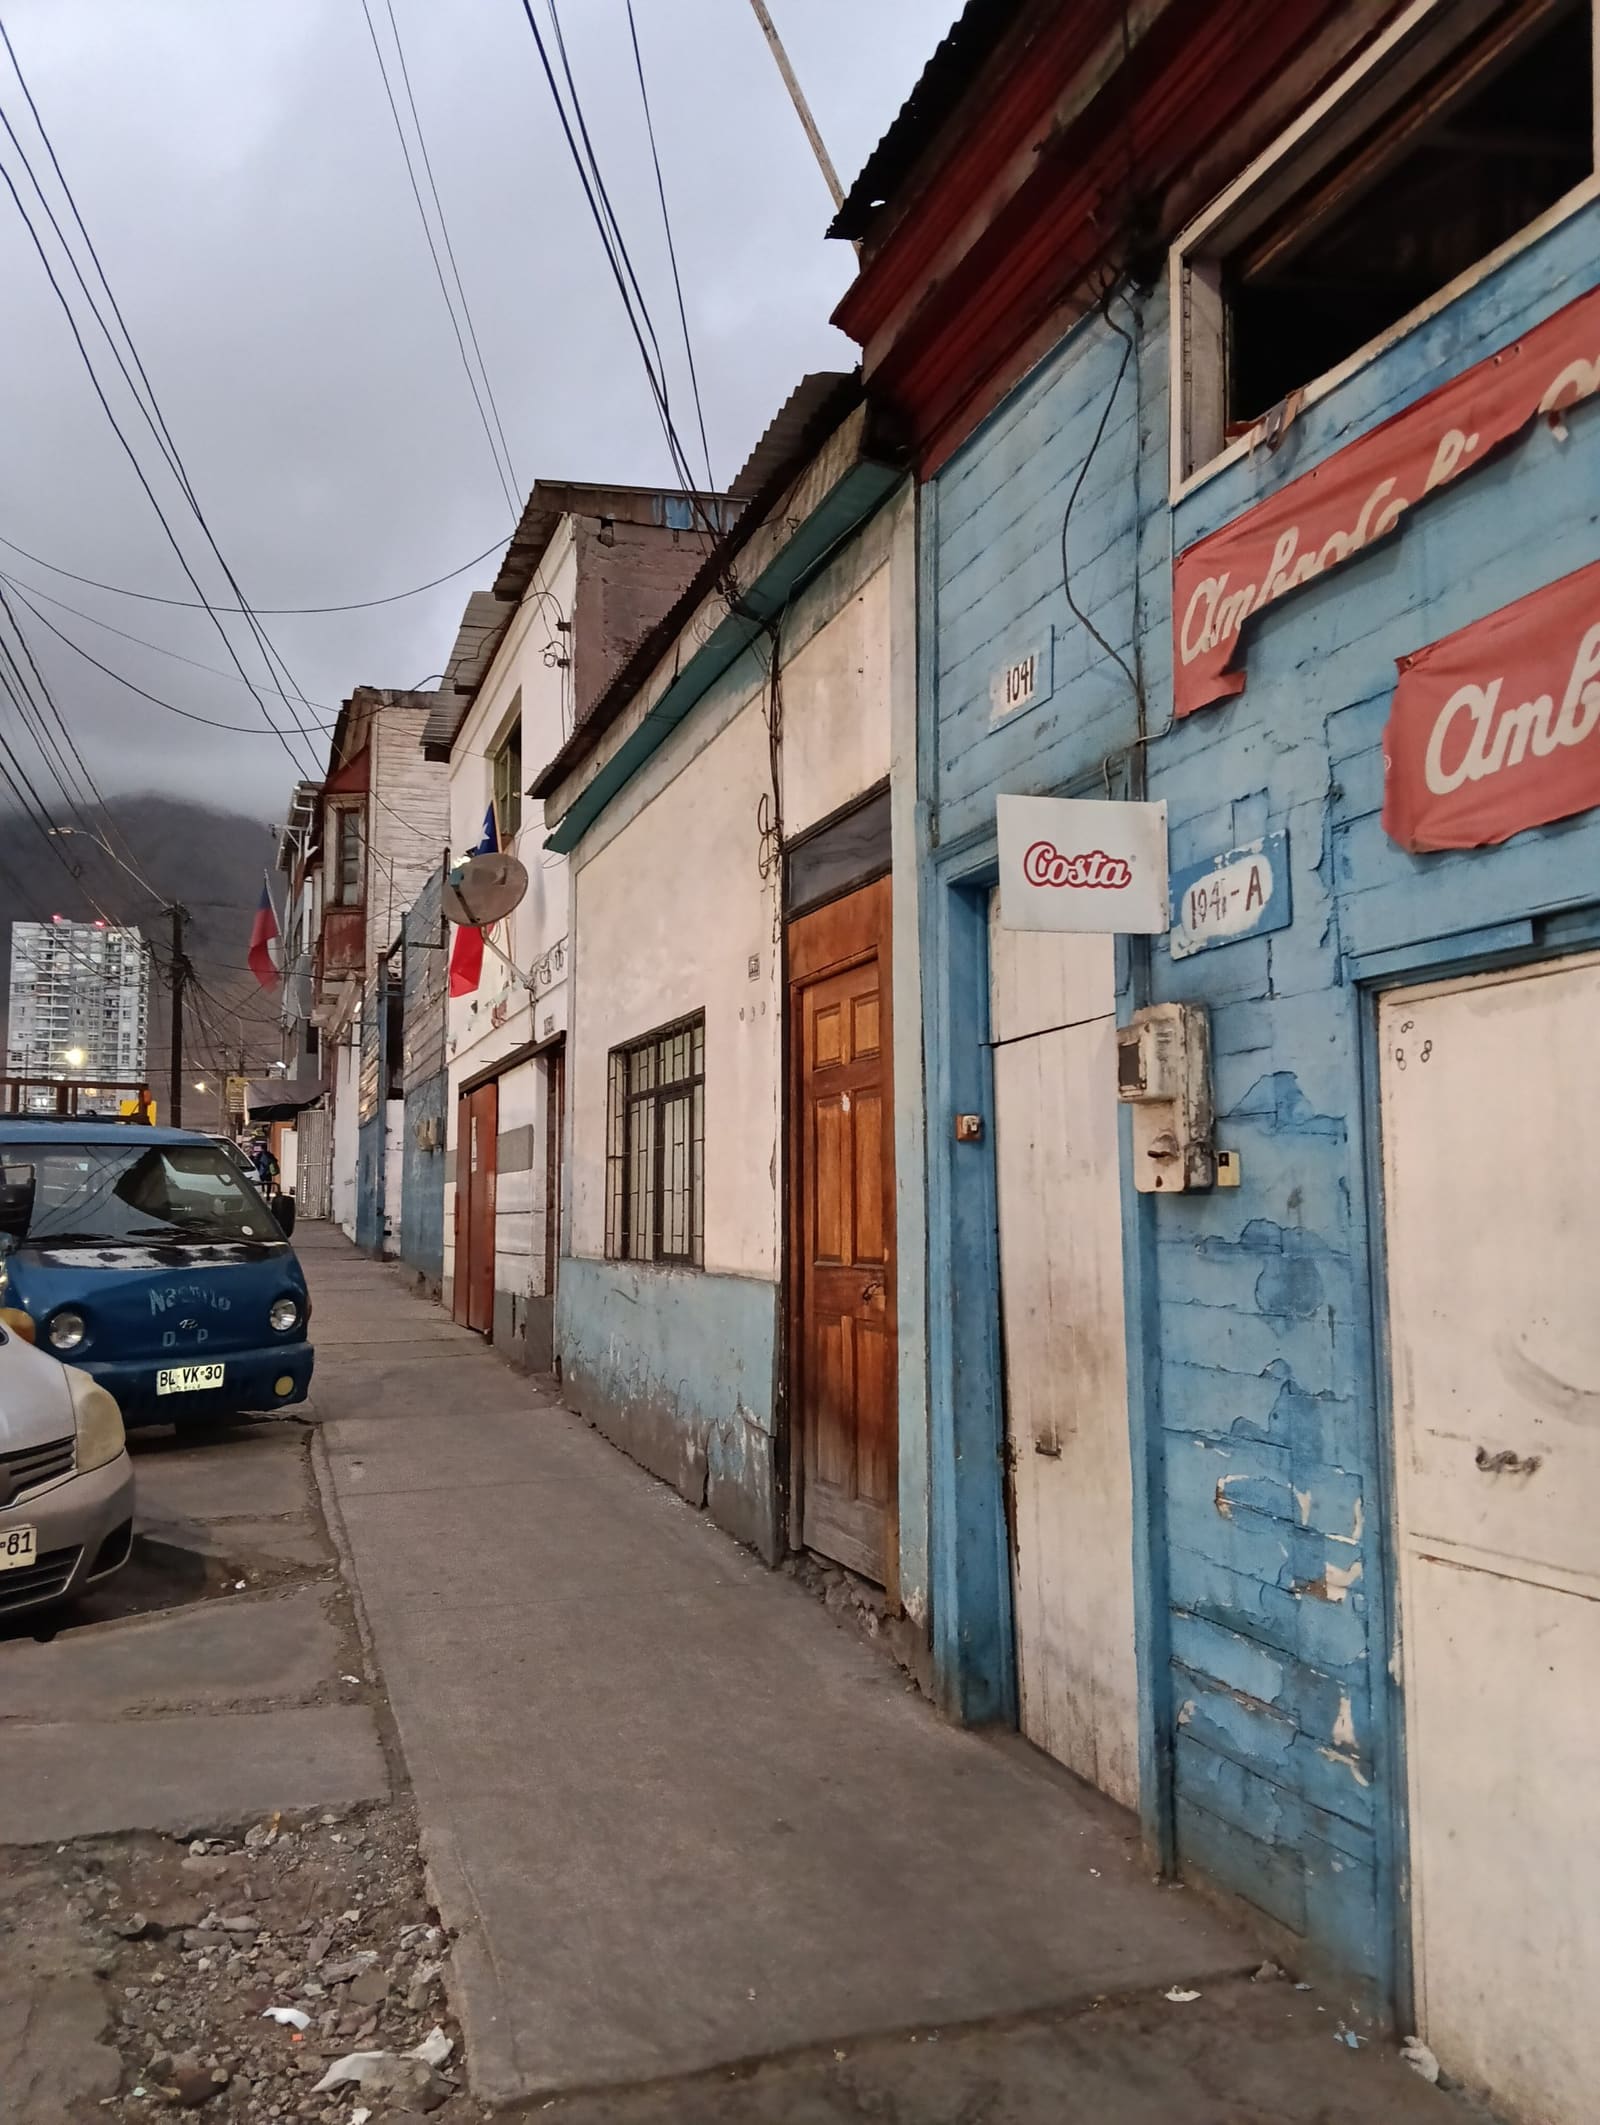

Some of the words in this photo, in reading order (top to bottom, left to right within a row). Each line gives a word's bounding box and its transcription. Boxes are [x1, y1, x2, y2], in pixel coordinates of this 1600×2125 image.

[1181, 429, 1480, 666] Ambrosl
[1006, 655, 1034, 704] 1041
[1024, 840, 1132, 889] Costa
